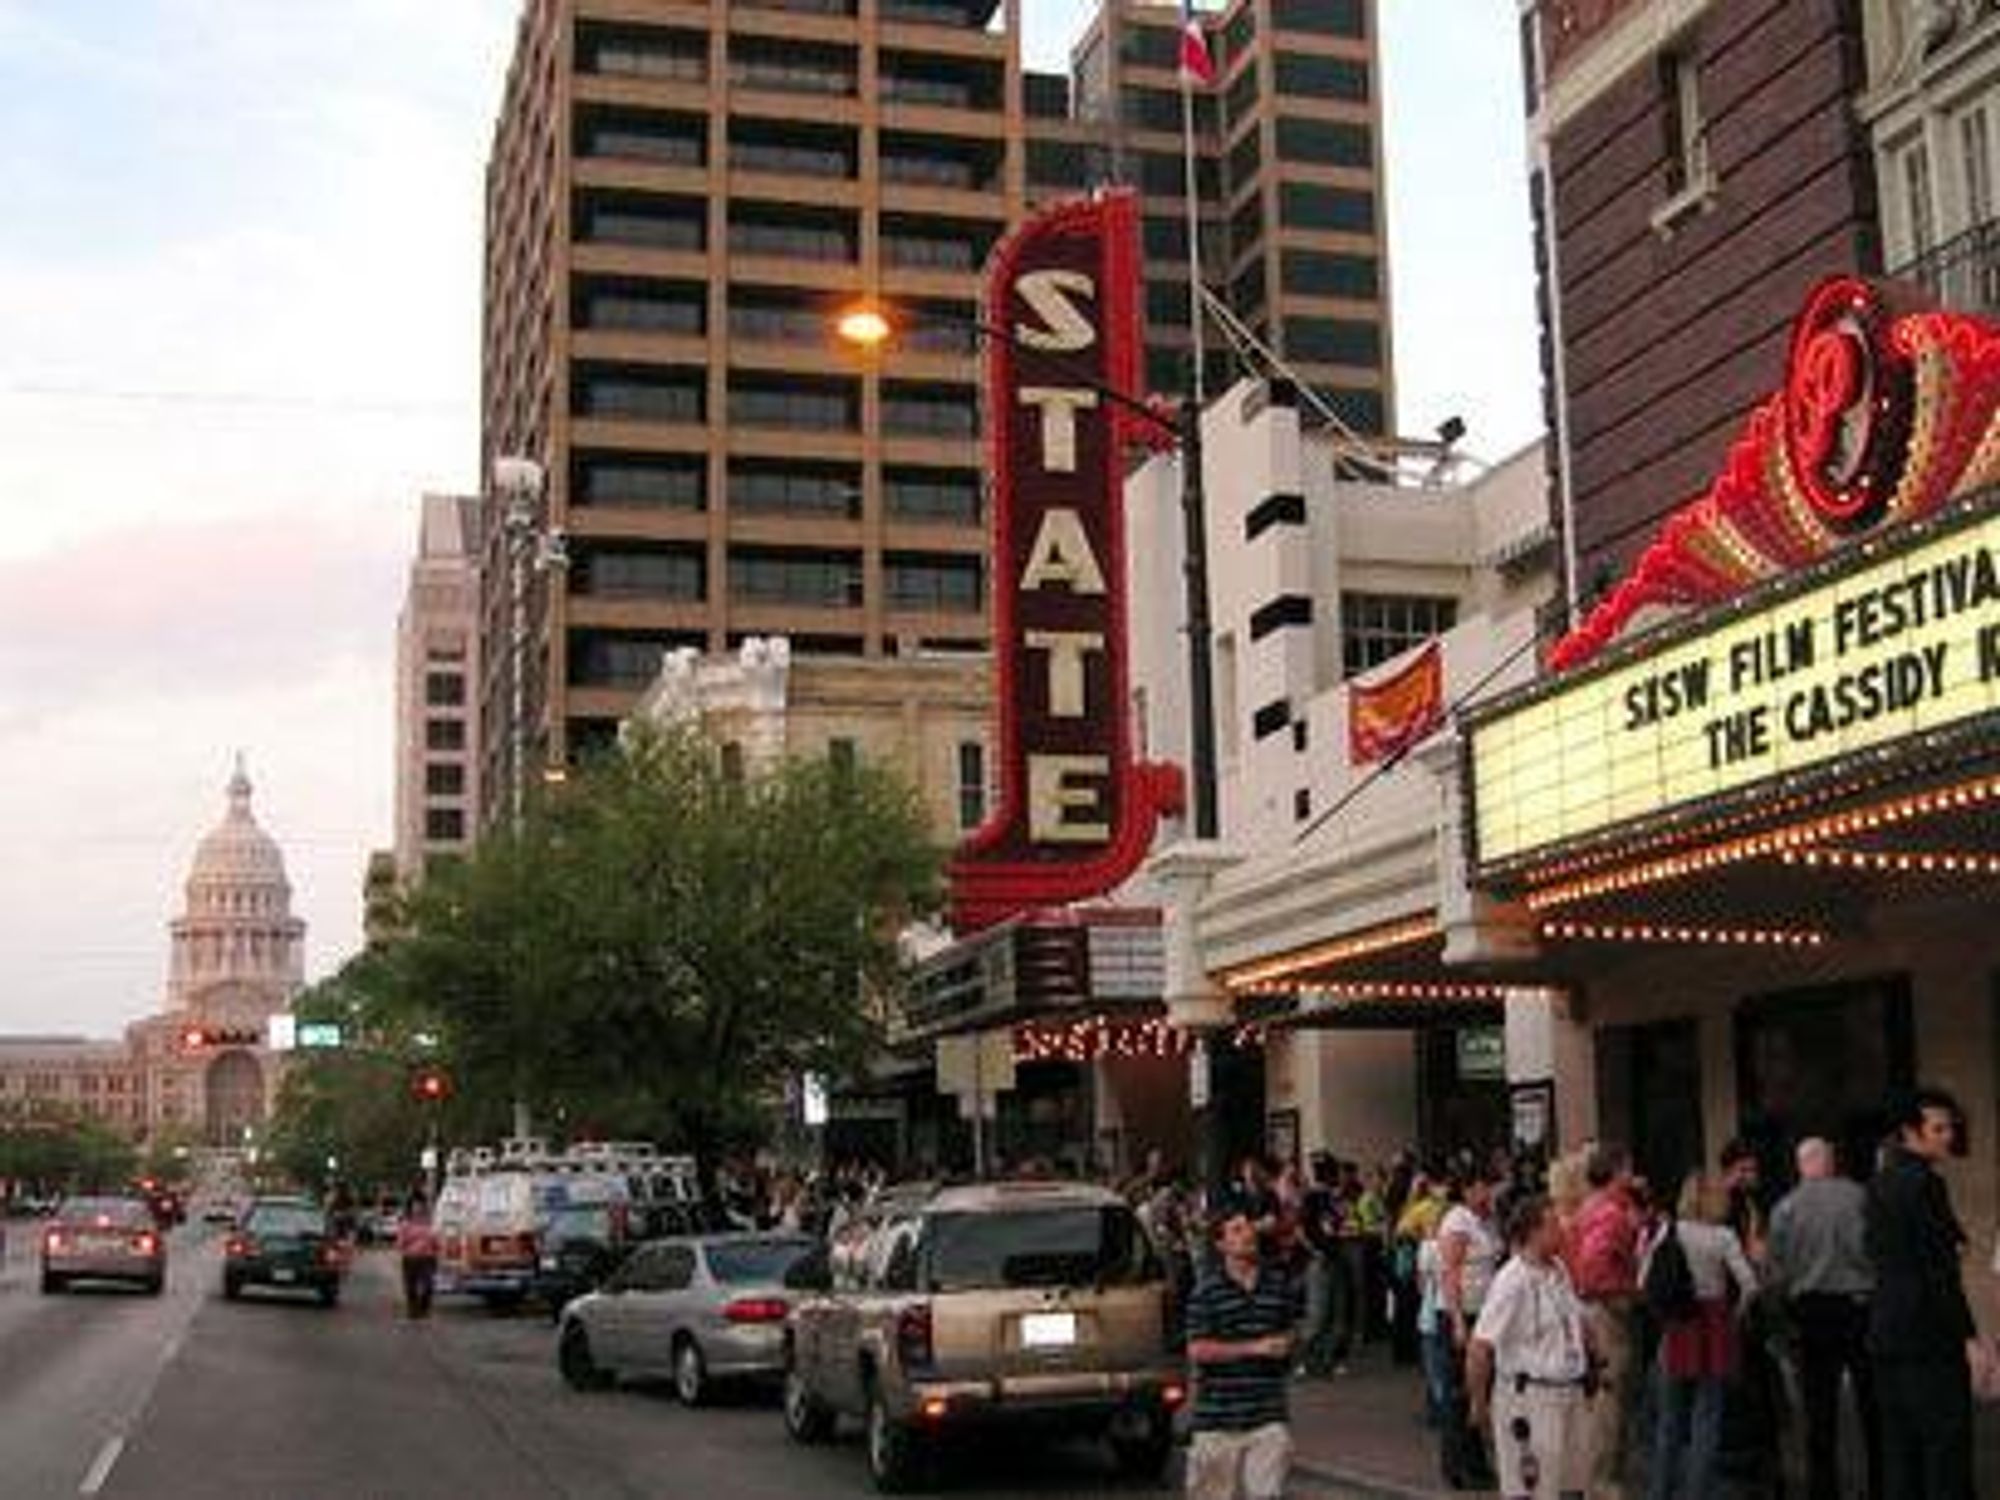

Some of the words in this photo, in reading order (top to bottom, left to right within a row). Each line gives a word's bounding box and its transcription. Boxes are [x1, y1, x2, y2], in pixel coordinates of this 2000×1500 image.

[1016, 268, 1112, 844] STATE
[1625, 656, 1709, 730] SXSW
[1730, 617, 1815, 694] FILM
[1703, 704, 1771, 770] THE
[1785, 642, 1948, 742] CASSIDY
